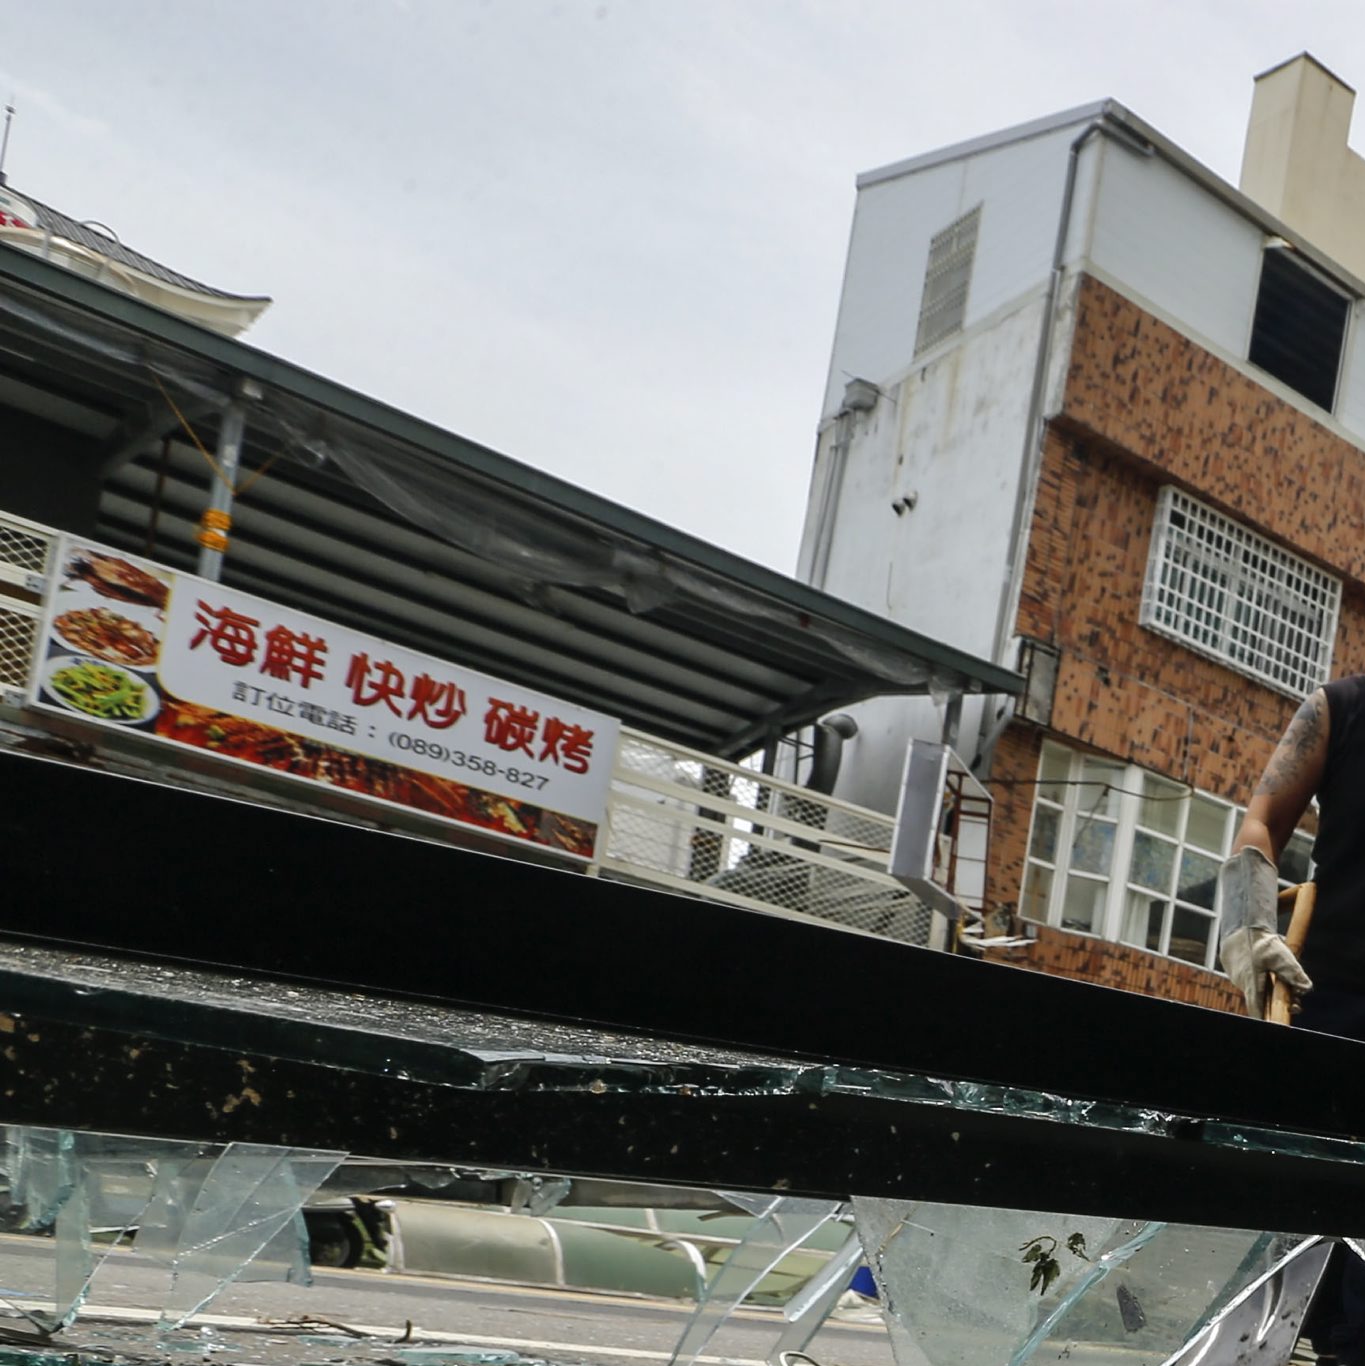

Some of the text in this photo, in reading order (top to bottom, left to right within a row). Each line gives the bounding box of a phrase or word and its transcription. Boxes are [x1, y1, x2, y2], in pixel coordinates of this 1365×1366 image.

[189, 598, 595, 775] 海鮮 快炒 碳烤
